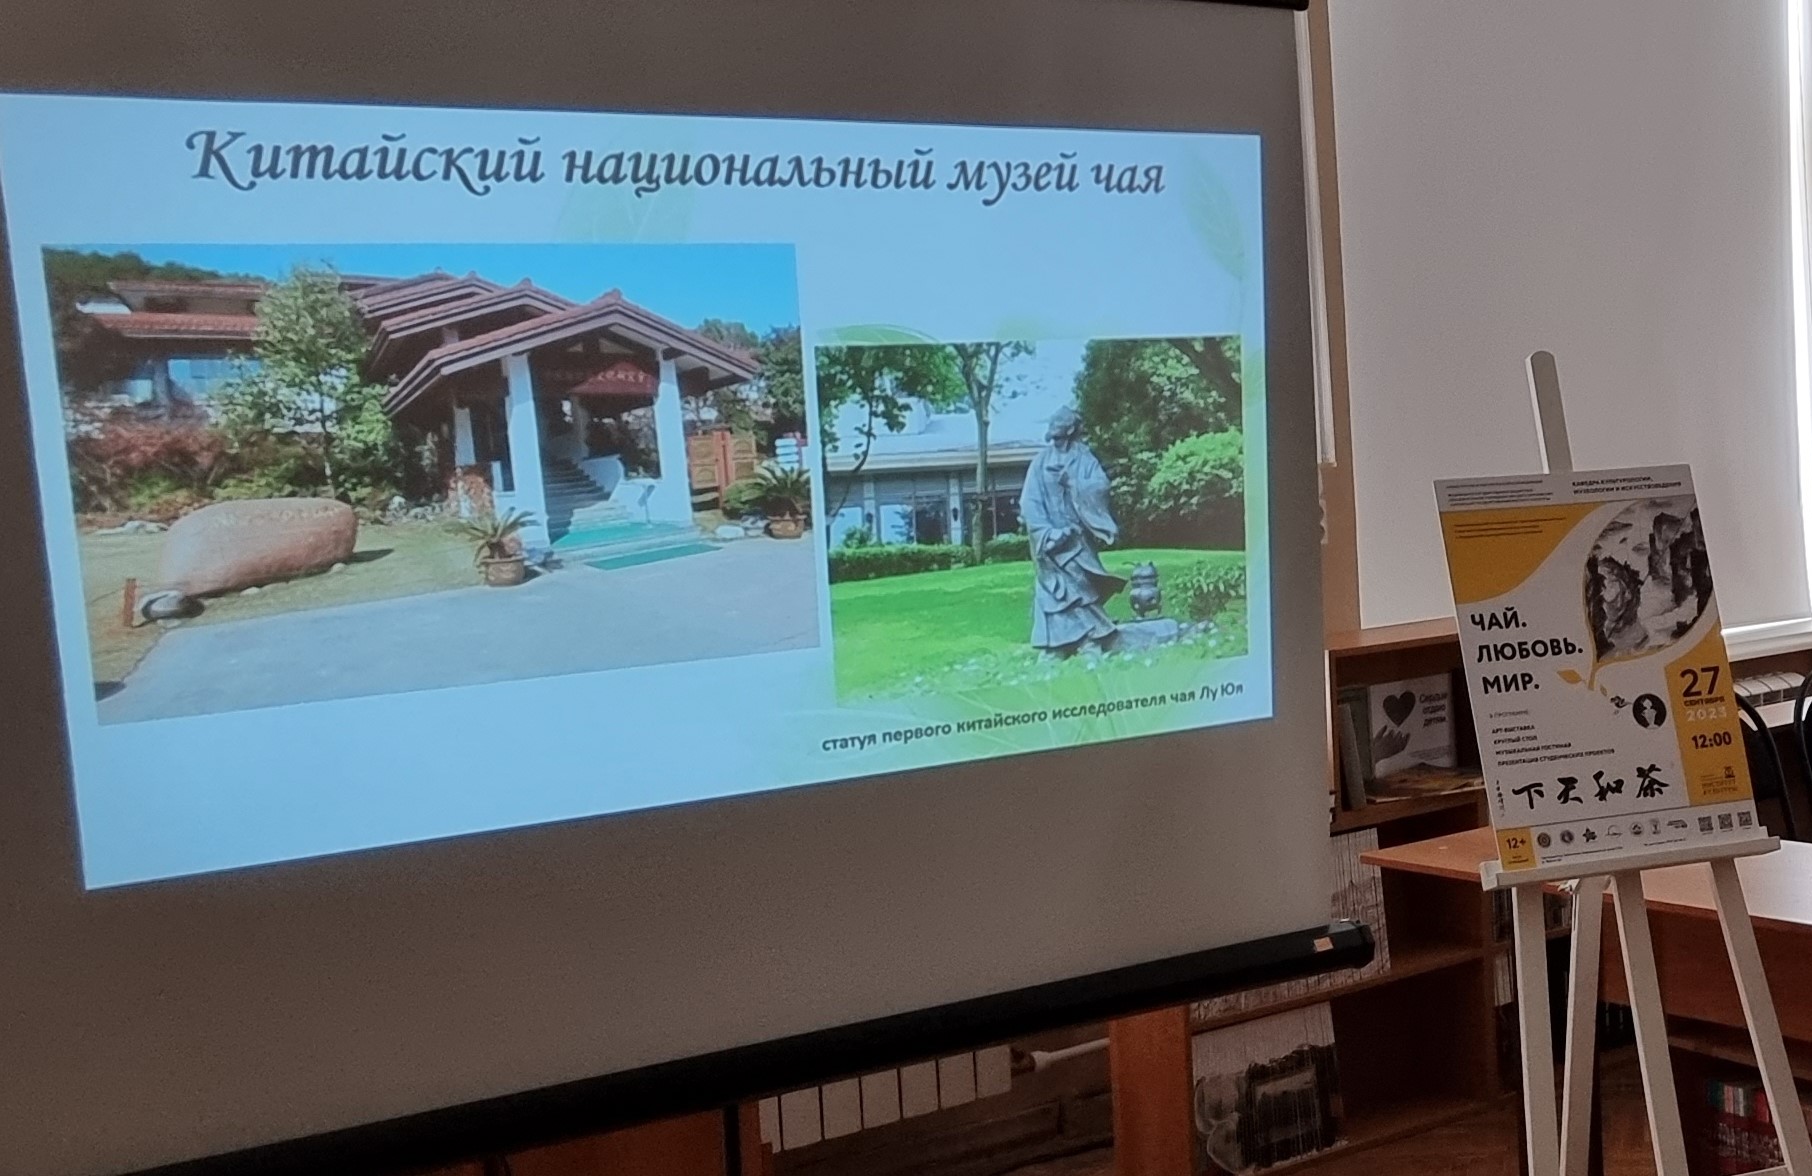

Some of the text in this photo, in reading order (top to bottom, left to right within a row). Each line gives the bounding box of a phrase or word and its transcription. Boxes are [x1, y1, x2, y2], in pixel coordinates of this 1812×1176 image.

[185, 130, 1167, 207] Китайский национальный музей чая
[1470, 606, 1527, 631] ЧАЙ.
[1477, 637, 1583, 663] ЛЮБОВЬ.
[1482, 672, 1540, 695] МИР.
[1680, 665, 1720, 698] 27
[1684, 696, 1726, 707] СЕНТЯБРЯ
[821, 682, 1245, 752] статуя первого китайского исследователя чая Лу Юя
[1687, 706, 1728, 722] 2023
[1691, 731, 1732, 750] 12:00
[1506, 837, 1527, 849] 12+
